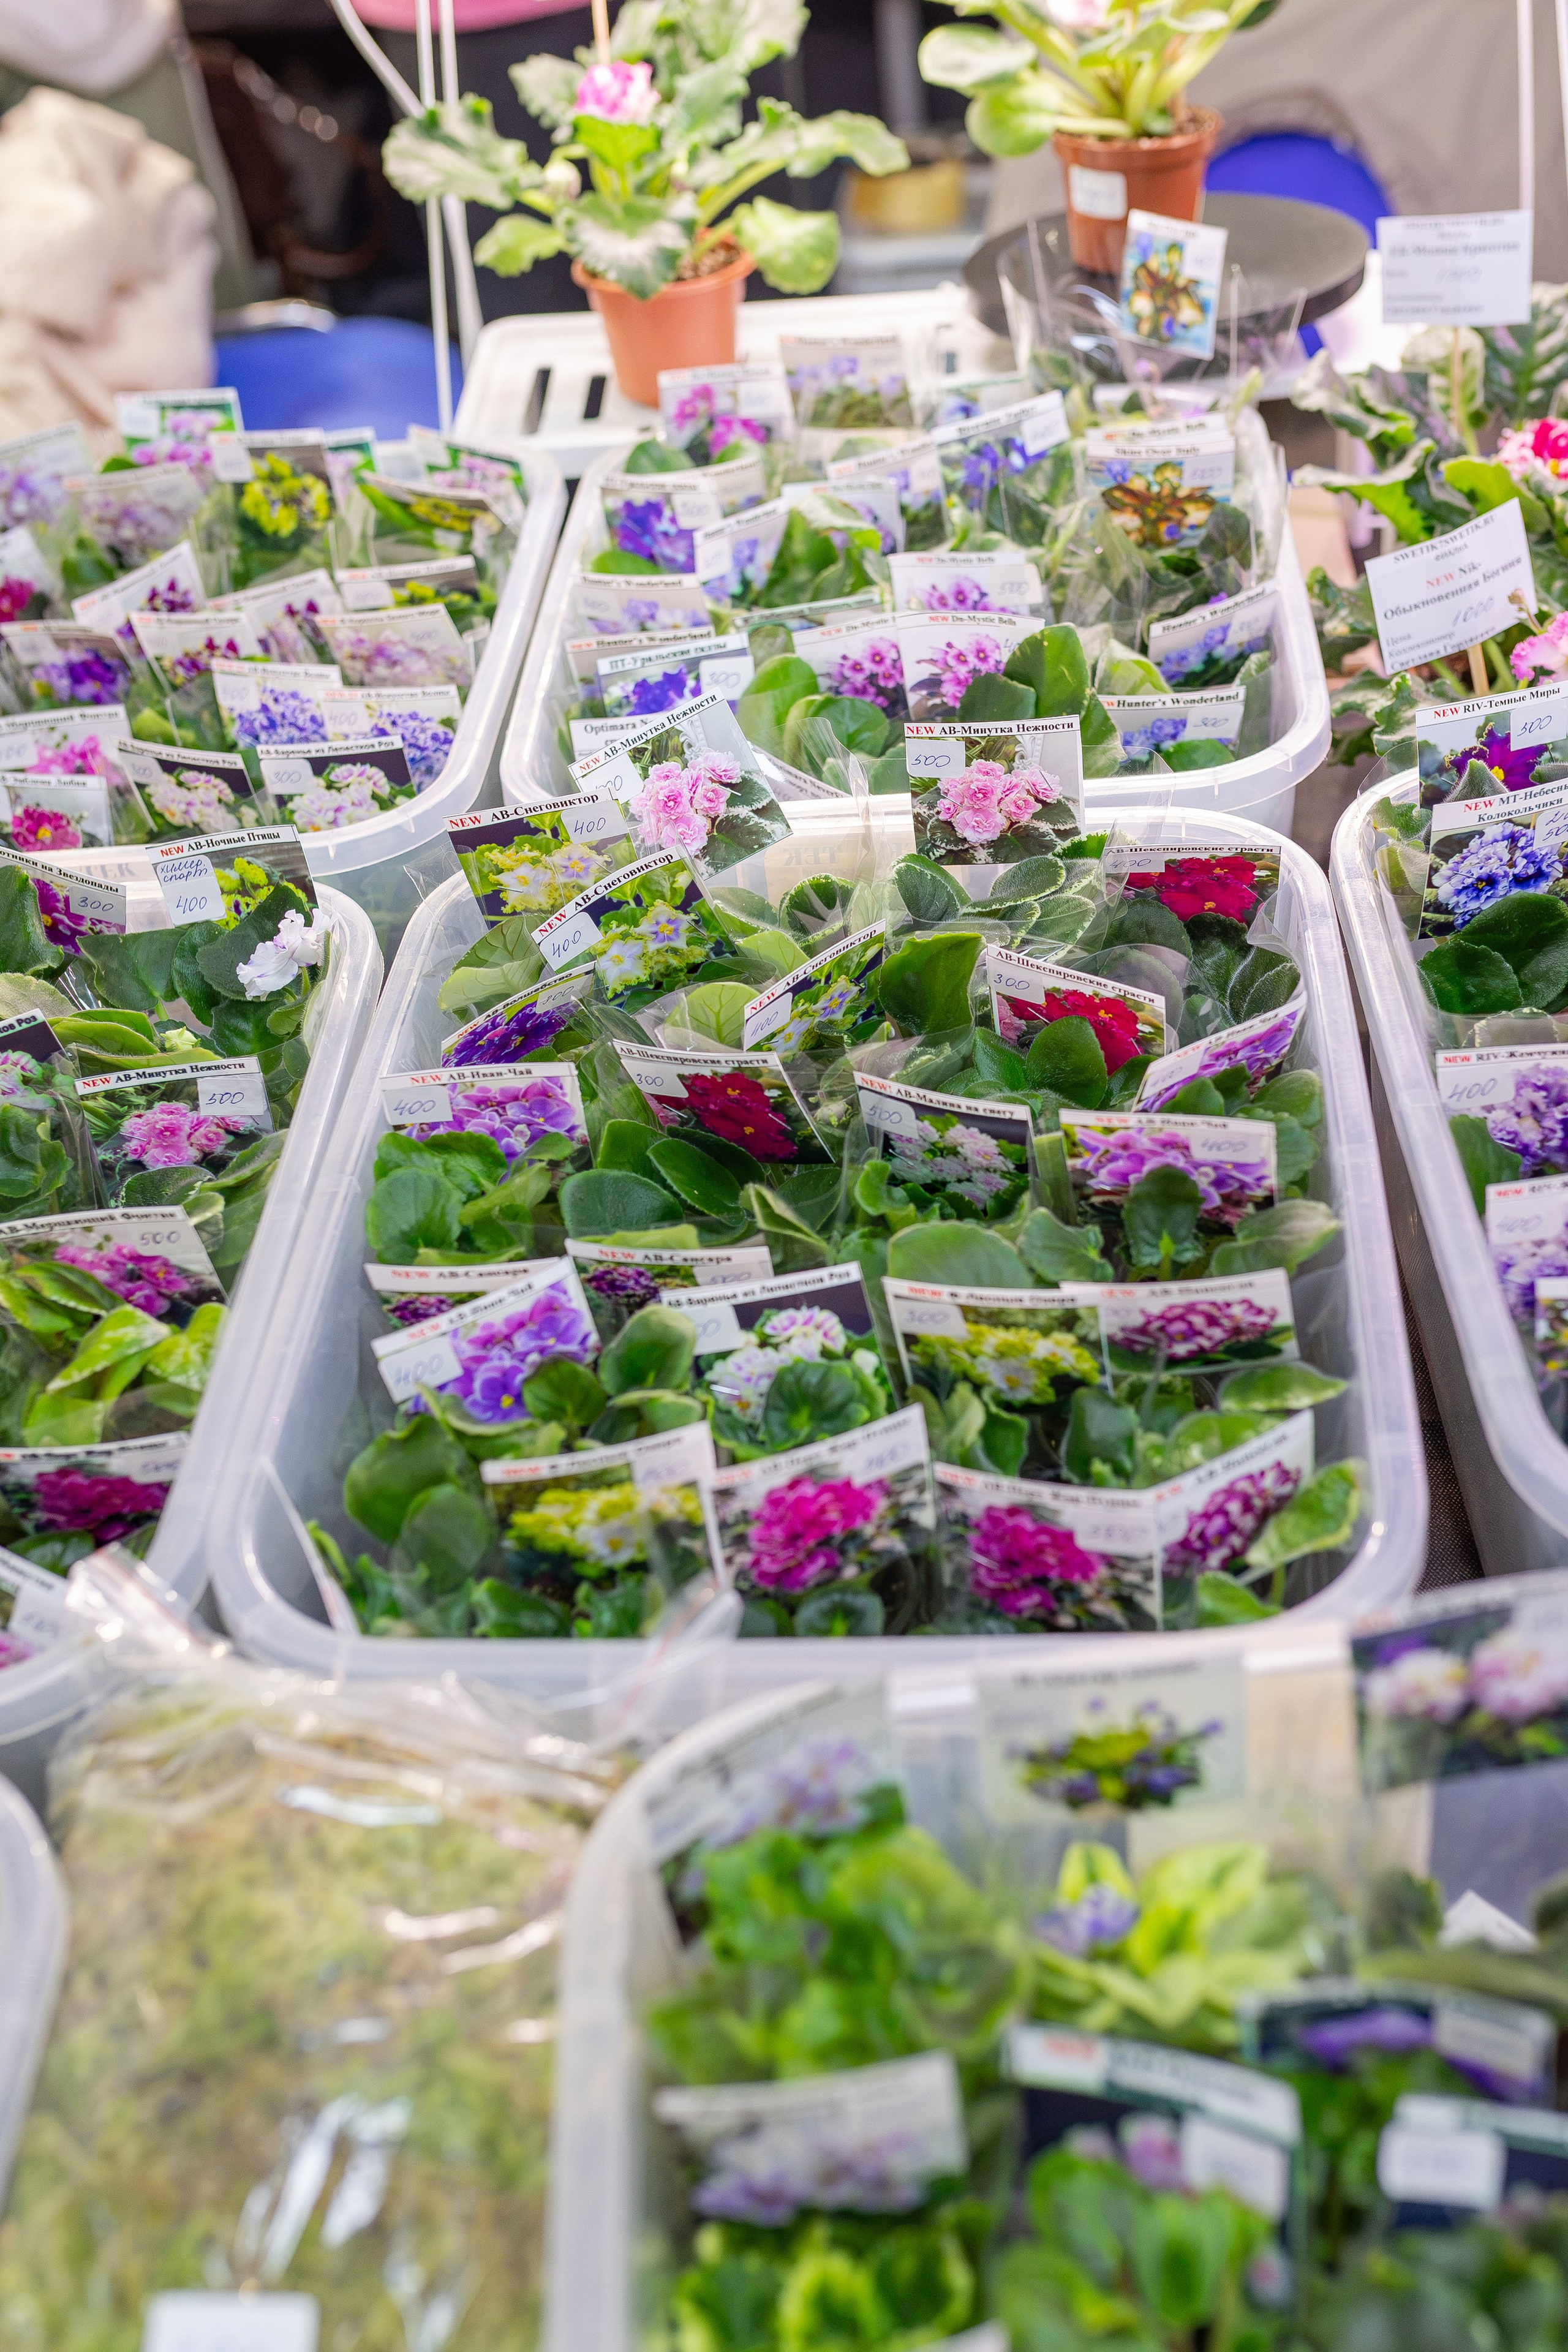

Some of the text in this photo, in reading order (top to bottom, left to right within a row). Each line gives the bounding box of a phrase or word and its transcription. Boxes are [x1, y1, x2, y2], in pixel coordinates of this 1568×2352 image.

[1426, 572, 1455, 590] NEW
[998, 617, 1017, 626] Bells
[1117, 692, 1239, 708] Hunter's Wonderland
[1433, 687, 1561, 719] NEW RIV-Темные Миры
[579, 693, 717, 773] NEW АВ-Минутка Нежности
[584, 722, 637, 735] Optimara
[906, 722, 1074, 737] NEW АВ-Минутка Нежности
[1517, 715, 1553, 737] 500
[378, 740, 395, 748] Роз
[911, 753, 951, 768] 500
[271, 770, 303, 785] 300
[448, 793, 600, 829] NEW АВ-Снеговиктор
[1463, 799, 1496, 813] NEW
[1477, 797, 1564, 823] Колокольчики
[573, 816, 606, 835] 400
[160, 829, 281, 858] NEW АВ-Ночные Птицы
[1106, 846, 1225, 855] АВ-Шекспировские
[1109, 858, 1152, 869] 400
[41, 864, 53, 873] на
[56, 867, 119, 894] Звездопады
[77, 895, 115, 913] 300
[538, 852, 674, 938] NEW АВ-Снеговиктор
[175, 895, 208, 916] 400
[551, 929, 582, 958] 400
[748, 929, 877, 1015] NEW АВ-Снеговиктор
[996, 950, 1155, 1005] АВ-Шекспировские страсти
[993, 973, 1030, 990] 300
[457, 972, 573, 1039] NEW АВ-Волшебство
[17, 1016, 37, 1027] Роз
[618, 1046, 769, 1066] АВ-Шекспировские страсти
[1443, 1055, 1472, 1063] NEW
[82, 1060, 246, 1090] NEW АВ-Минутка Нежности
[409, 1066, 533, 1085] NEW АВ-Иван-Чай
[635, 1073, 665, 1088] 300
[205, 1090, 245, 1106] 500
[861, 1076, 893, 1094] NEW!
[966, 1104, 979, 1112] на
[982, 1107, 1016, 1120] снегу
[1447, 1076, 1499, 1102] 400
[393, 1098, 437, 1115] 400
[866, 1105, 903, 1125] 500
[140, 1229, 181, 1247] 500
[598, 1249, 636, 1260] NEW
[391, 1270, 431, 1280] NEW
